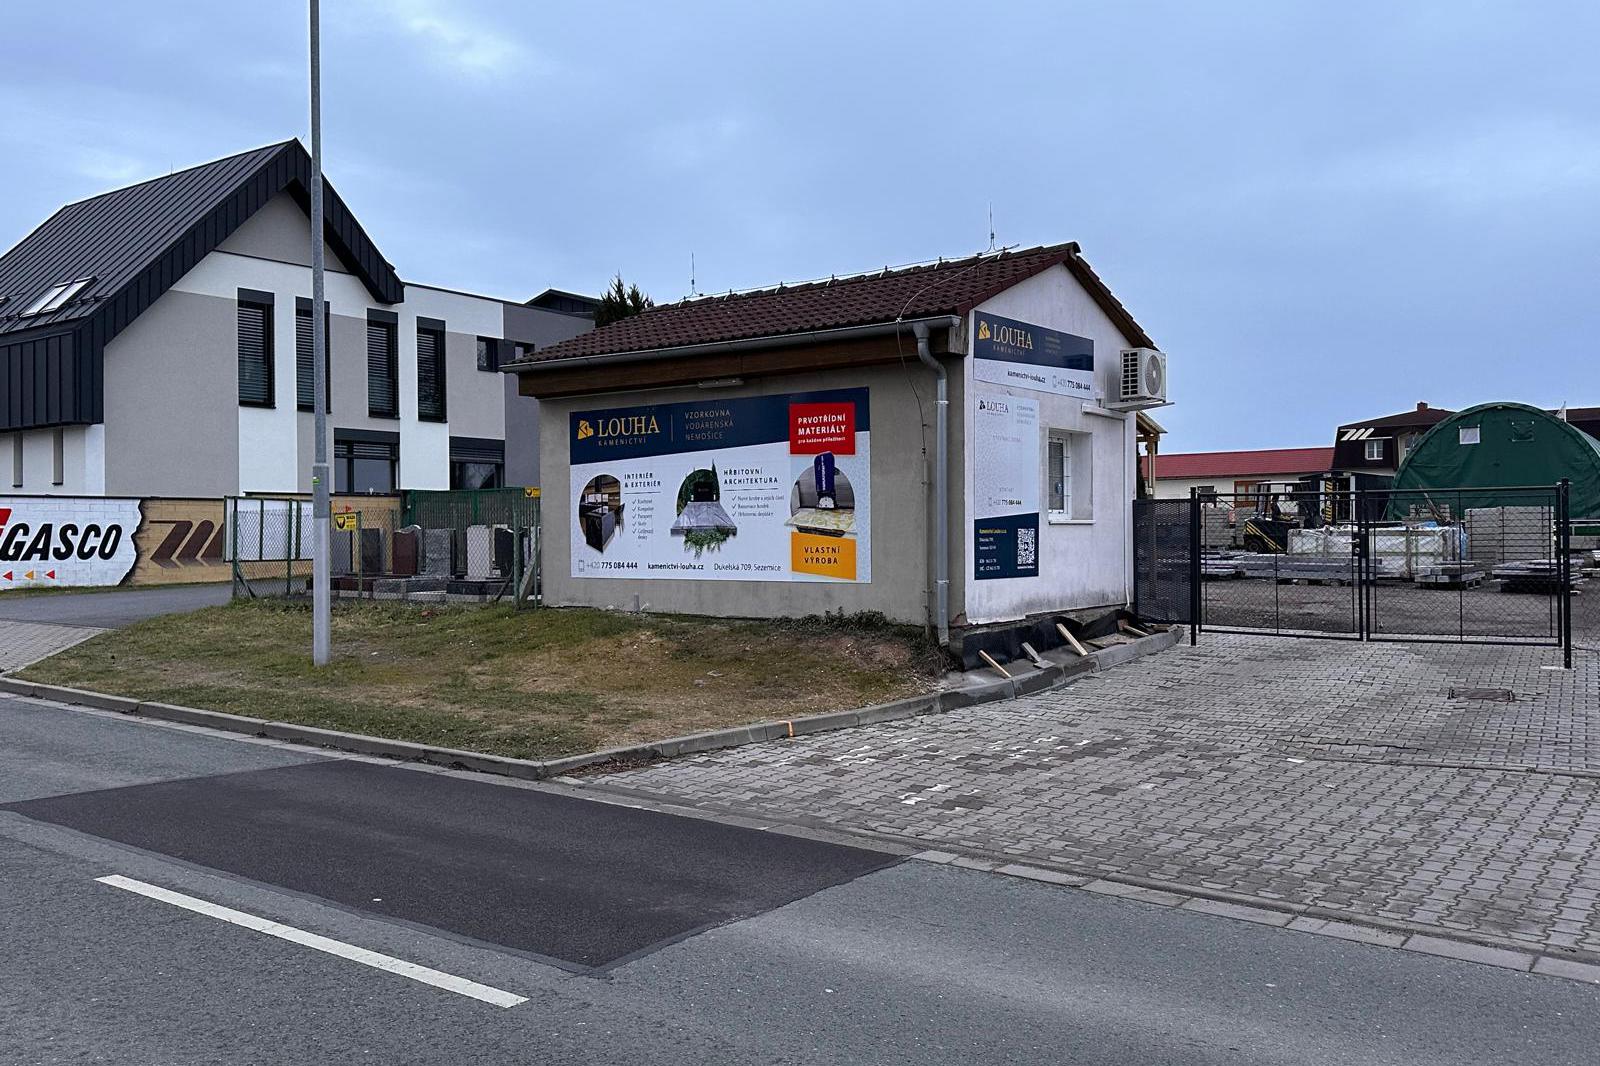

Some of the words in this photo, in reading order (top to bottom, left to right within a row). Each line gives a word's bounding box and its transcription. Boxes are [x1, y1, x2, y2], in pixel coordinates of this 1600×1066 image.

[993, 324, 1033, 350] LOUHA
[986, 401, 1009, 414] LOUHA
[685, 409, 731, 419] VZORKOVNA
[797, 413, 846, 424] PRVOTŘÍDNÍ
[598, 416, 660, 437] LOUHA
[797, 425, 846, 436] MATERIÁLY
[686, 431, 725, 441] NEMOŠICE
[624, 472, 654, 480] INTERIÉR
[723, 467, 763, 476] HŘBITOVNÍ
[631, 480, 661, 488] EXTERIÉR
[724, 477, 778, 485] ARCHITEKTURA
[0, 522, 123, 562] GASCO
[804, 546, 841, 554] VLASTNÍ
[804, 555, 839, 564] VÝROBA
[601, 561, 613, 570] 775
[613, 561, 624, 570] 084
[624, 561, 638, 570] 444
[647, 561, 704, 571] kamenictvi-louha.cz
[713, 562, 740, 571] Dukelská
[753, 563, 781, 571] Sezemice
